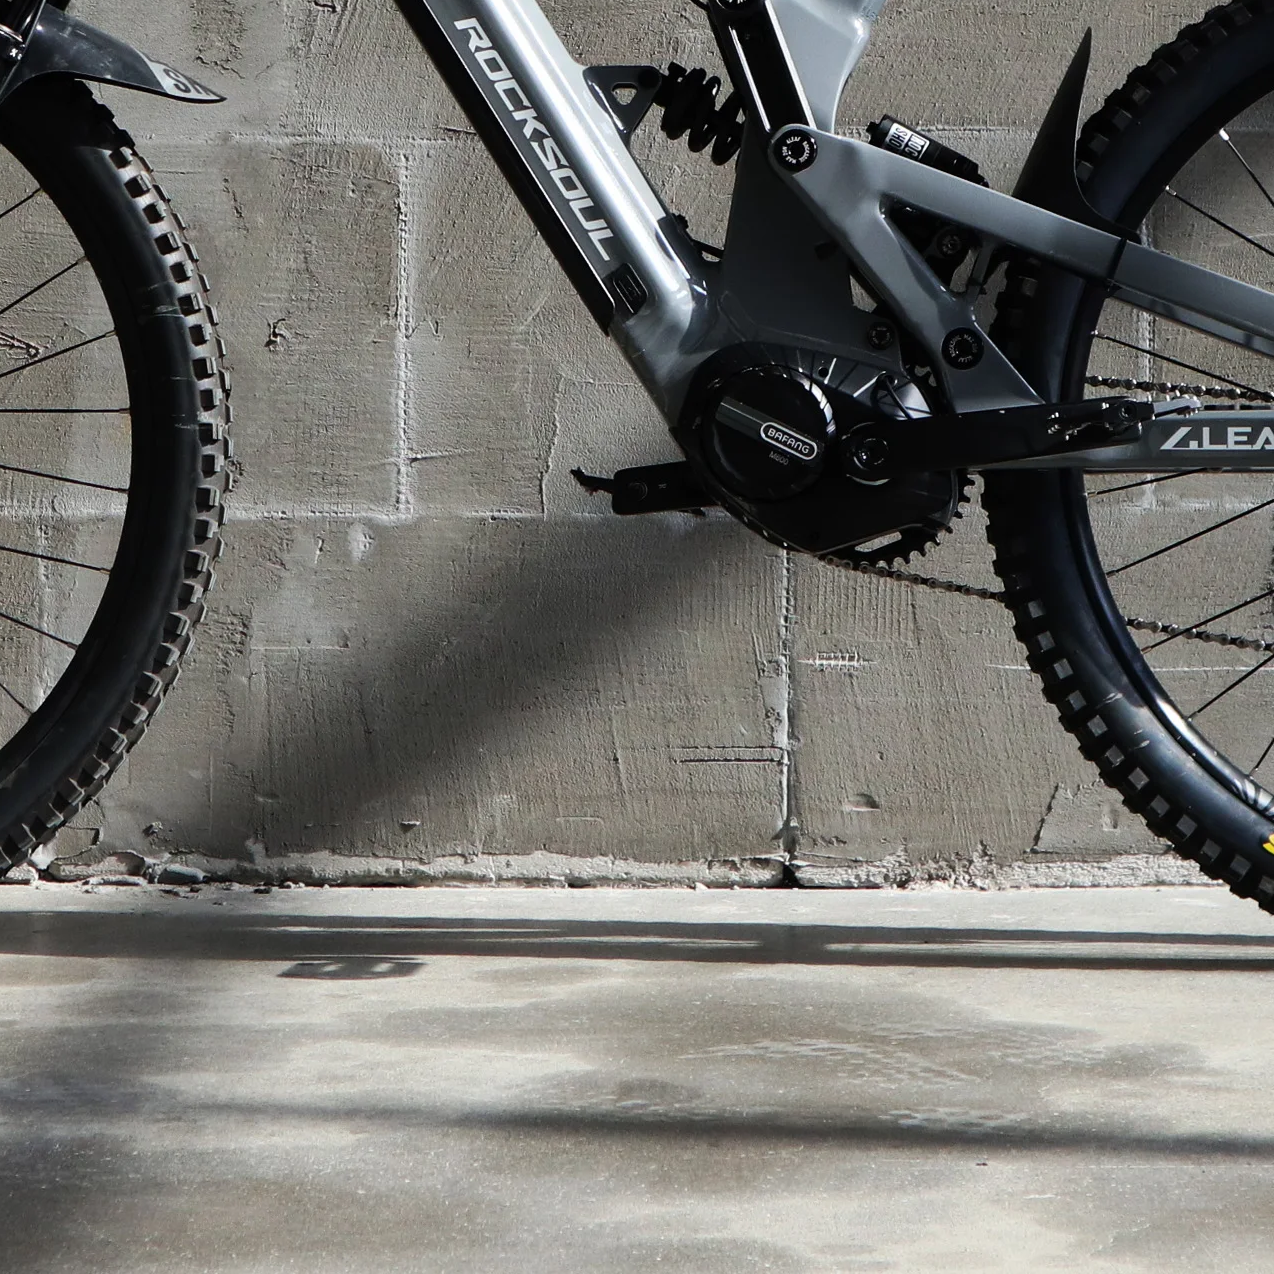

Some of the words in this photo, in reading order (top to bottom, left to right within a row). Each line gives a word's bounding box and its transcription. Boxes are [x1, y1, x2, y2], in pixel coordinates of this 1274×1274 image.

[454, 17, 614, 262] ROCKSOUL
[904, 135, 924, 158] ROC
[767, 427, 810, 454] BAFANG
